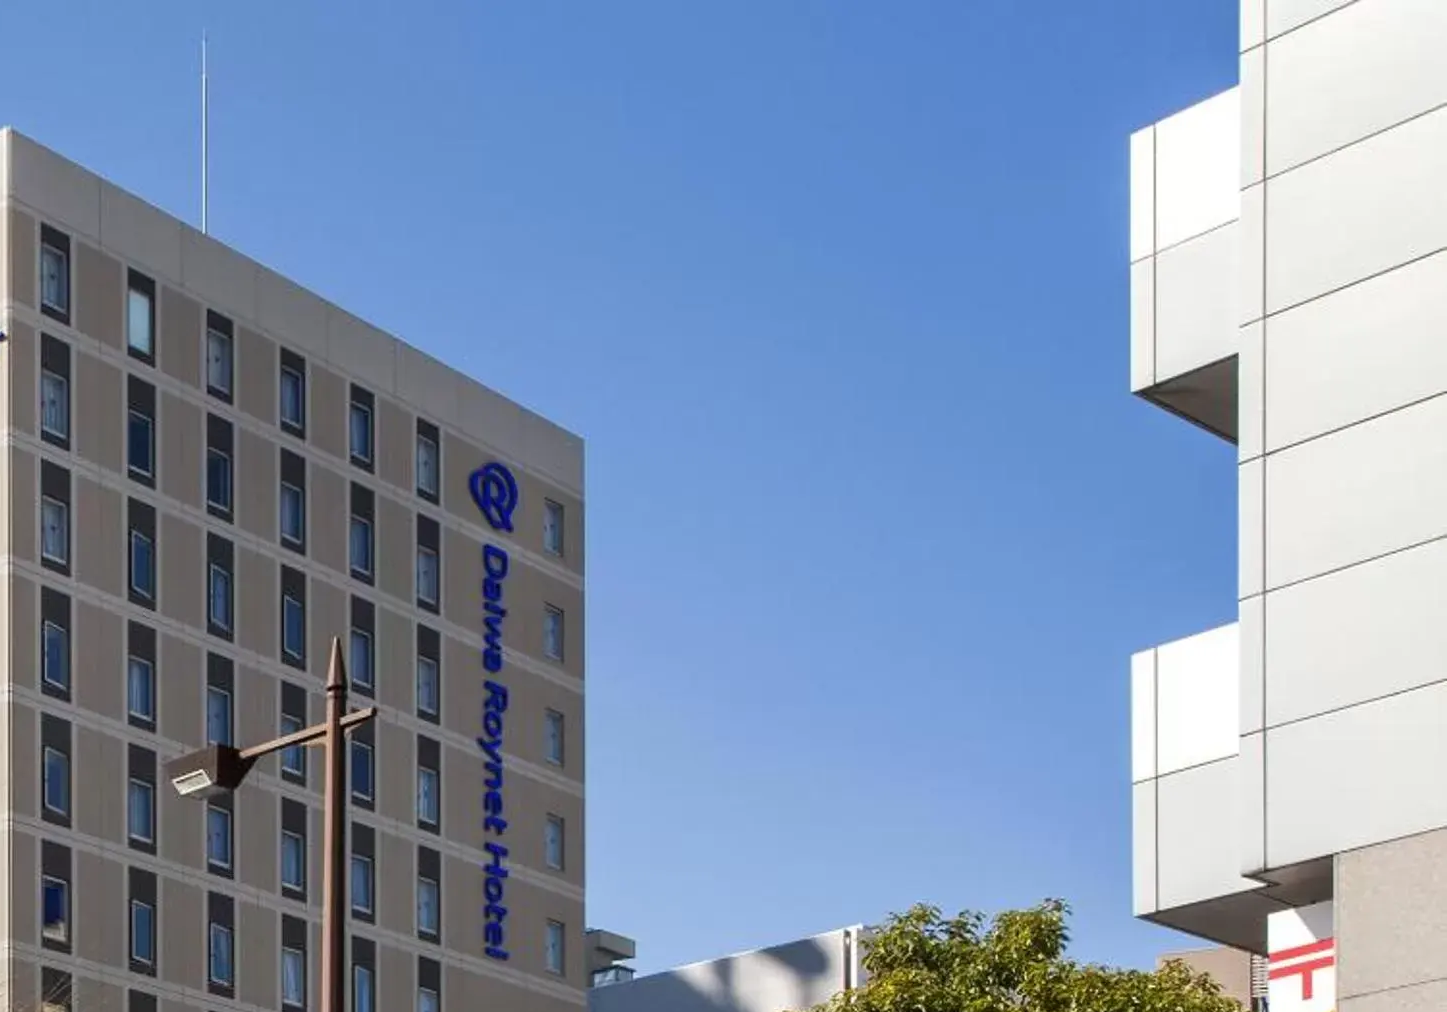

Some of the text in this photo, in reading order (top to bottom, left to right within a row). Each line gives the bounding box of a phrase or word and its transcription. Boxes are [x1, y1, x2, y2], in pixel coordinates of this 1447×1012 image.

[476, 543, 510, 961] Daiwa Roynet Hotel
